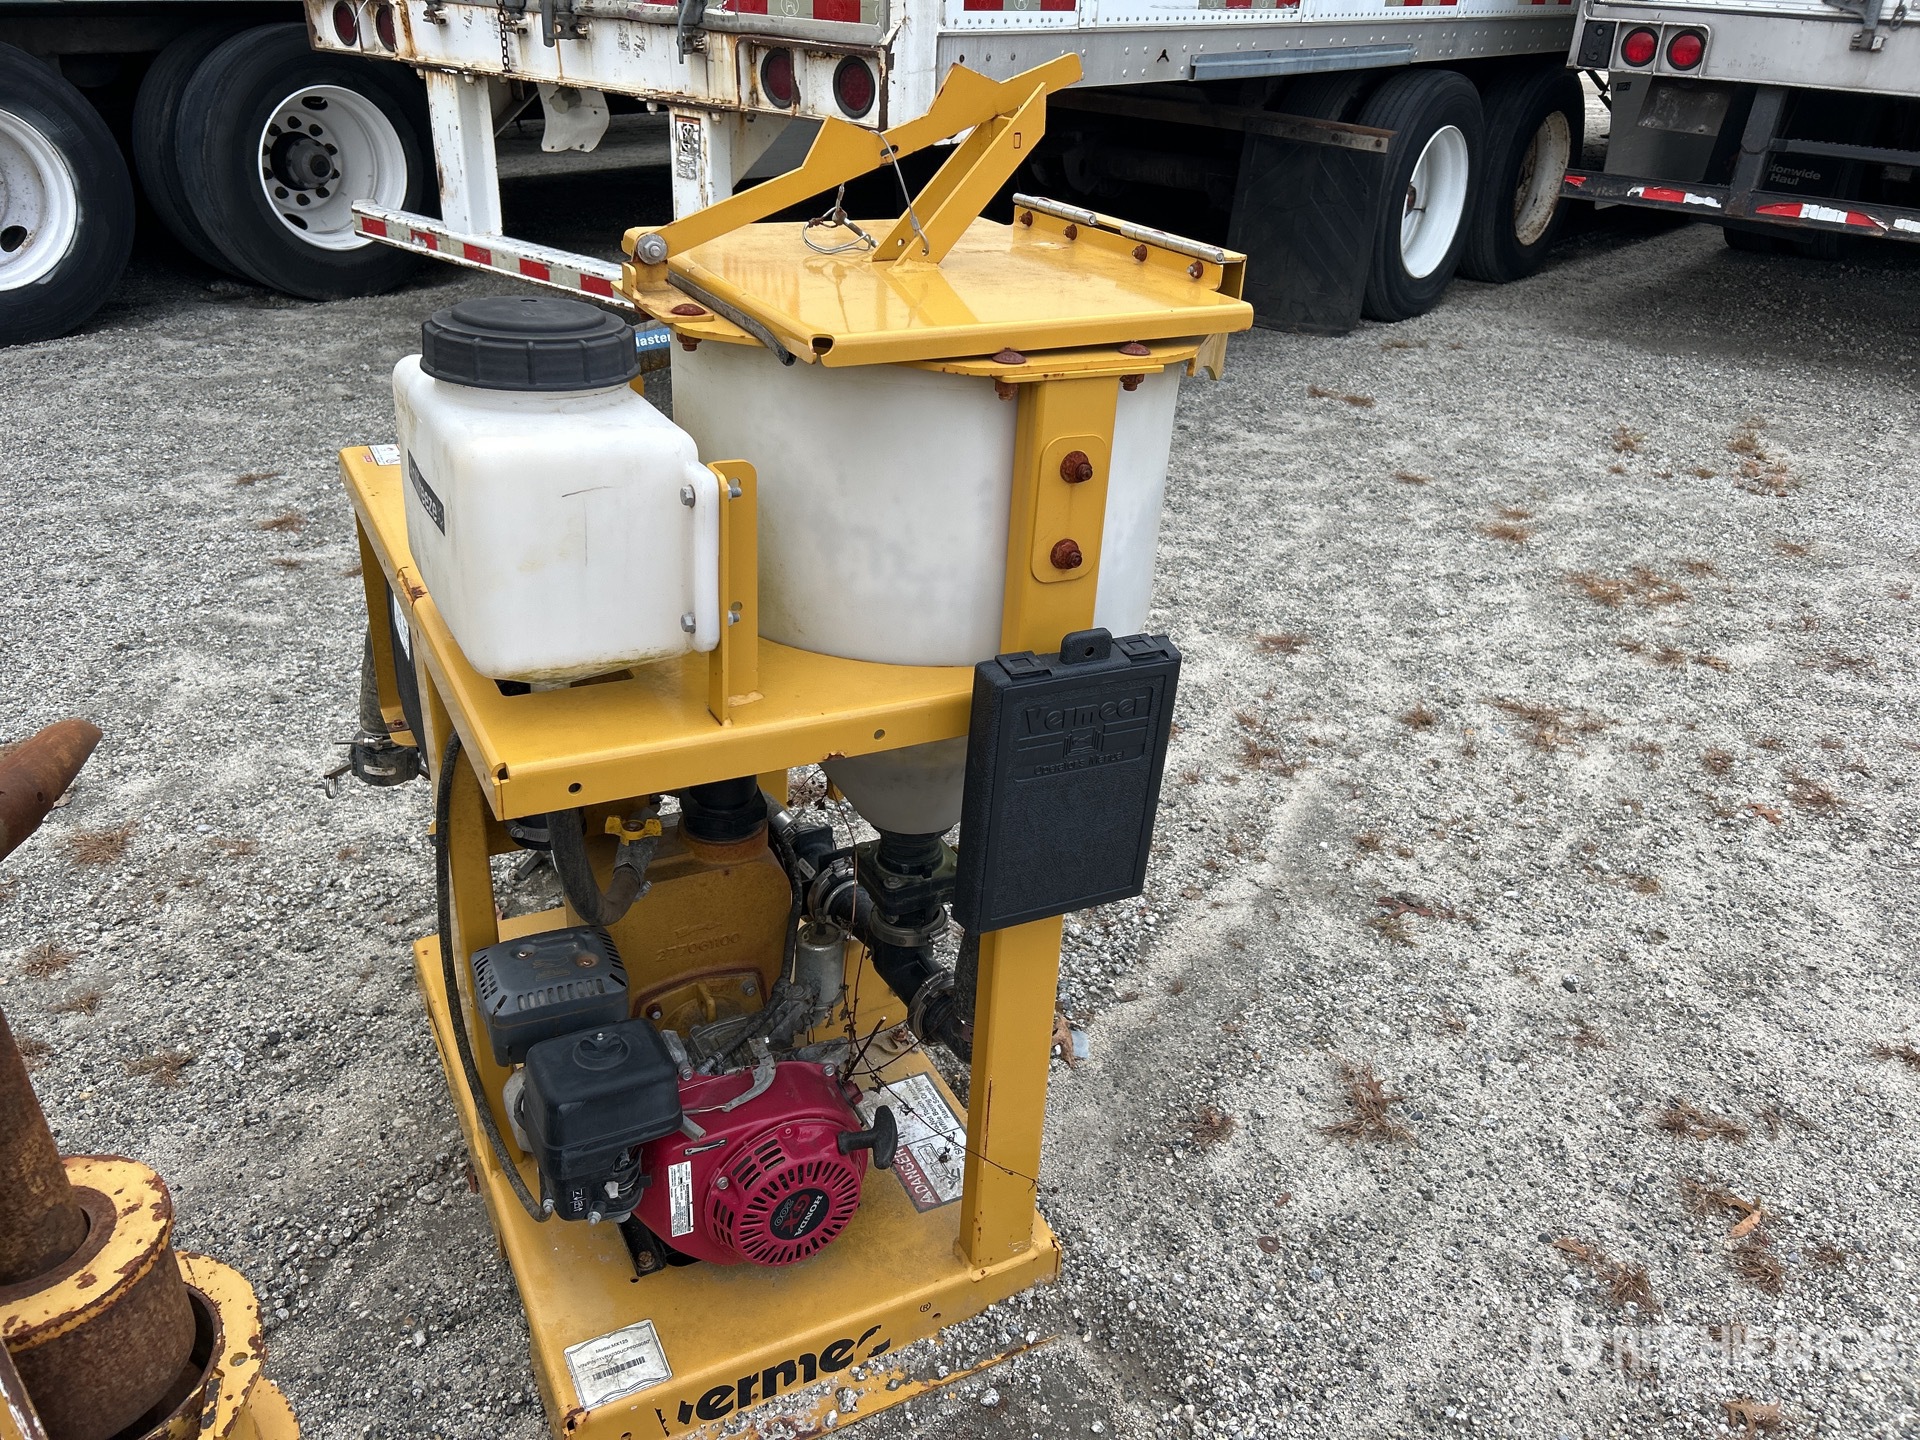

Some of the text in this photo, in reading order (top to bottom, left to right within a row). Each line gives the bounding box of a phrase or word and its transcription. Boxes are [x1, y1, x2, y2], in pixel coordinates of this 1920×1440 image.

[1769, 173, 1800, 186] Haul
[635, 333, 671, 347] aster
[1025, 696, 1147, 734] Vermeer
[1034, 751, 1125, 775] Operator's Manual
[916, 1099, 930, 1116] Touch
[923, 1097, 939, 1117] Boring
[924, 1084, 949, 1119] Alarm Sounds
[935, 1115, 948, 1131] While
[893, 1147, 928, 1195] DANGER
[774, 1199, 794, 1227] 200
[781, 1194, 811, 1233] GX
[794, 1195, 823, 1237] HONDA
